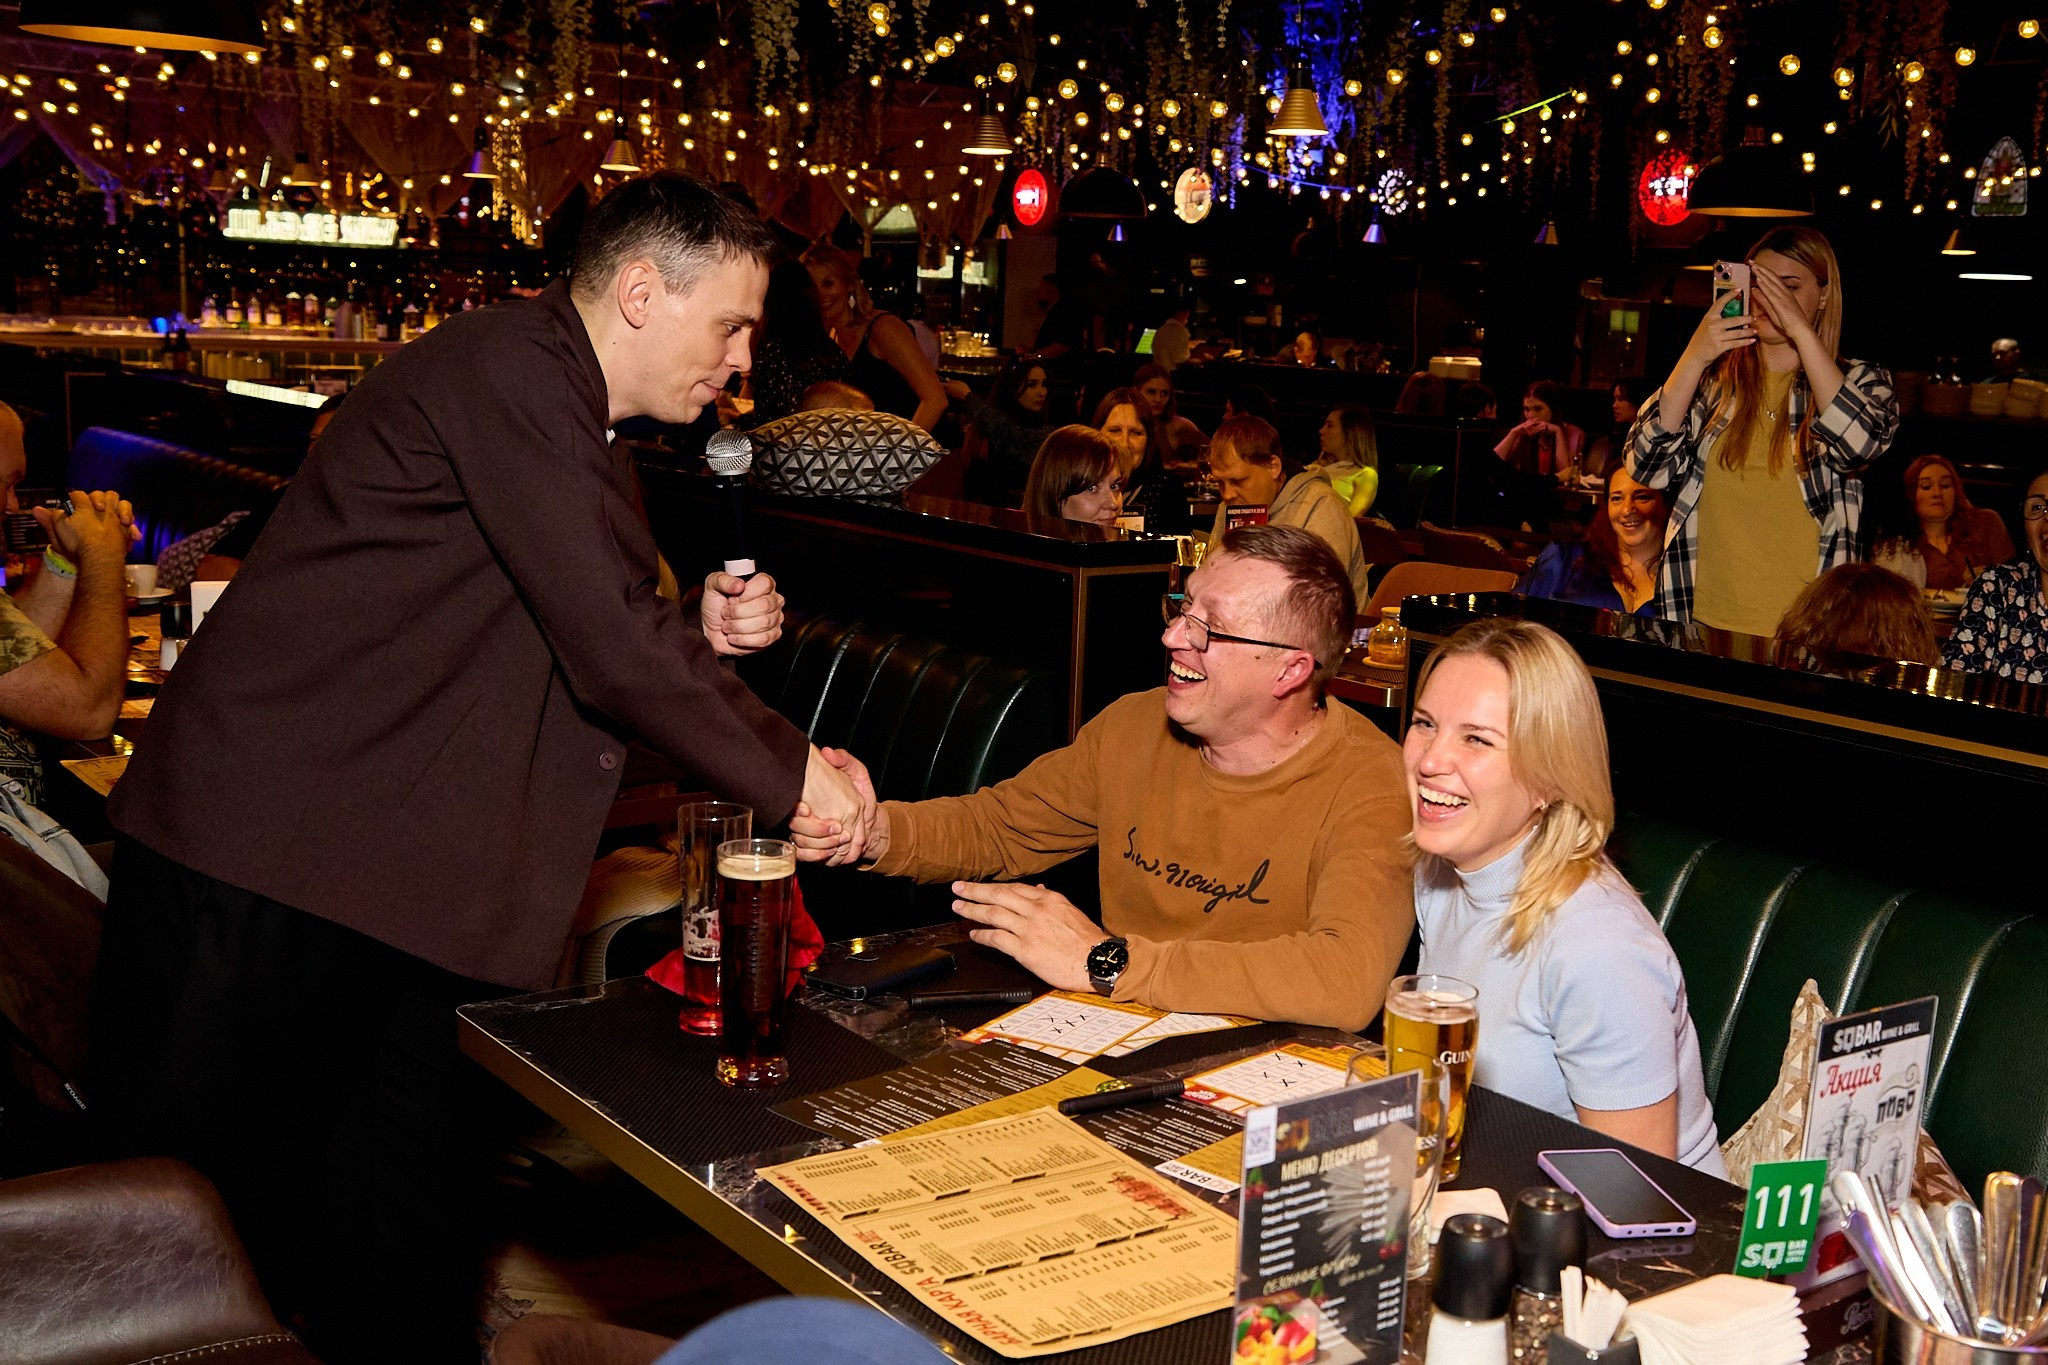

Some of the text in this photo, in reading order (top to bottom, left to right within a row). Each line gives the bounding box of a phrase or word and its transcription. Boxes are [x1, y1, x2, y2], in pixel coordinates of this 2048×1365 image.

[1820, 1062, 1883, 1099] Акция
[1281, 1138, 1379, 1182] МЕНЮ ДЕСЕРТОВ
[1755, 1183, 1814, 1229] 111
